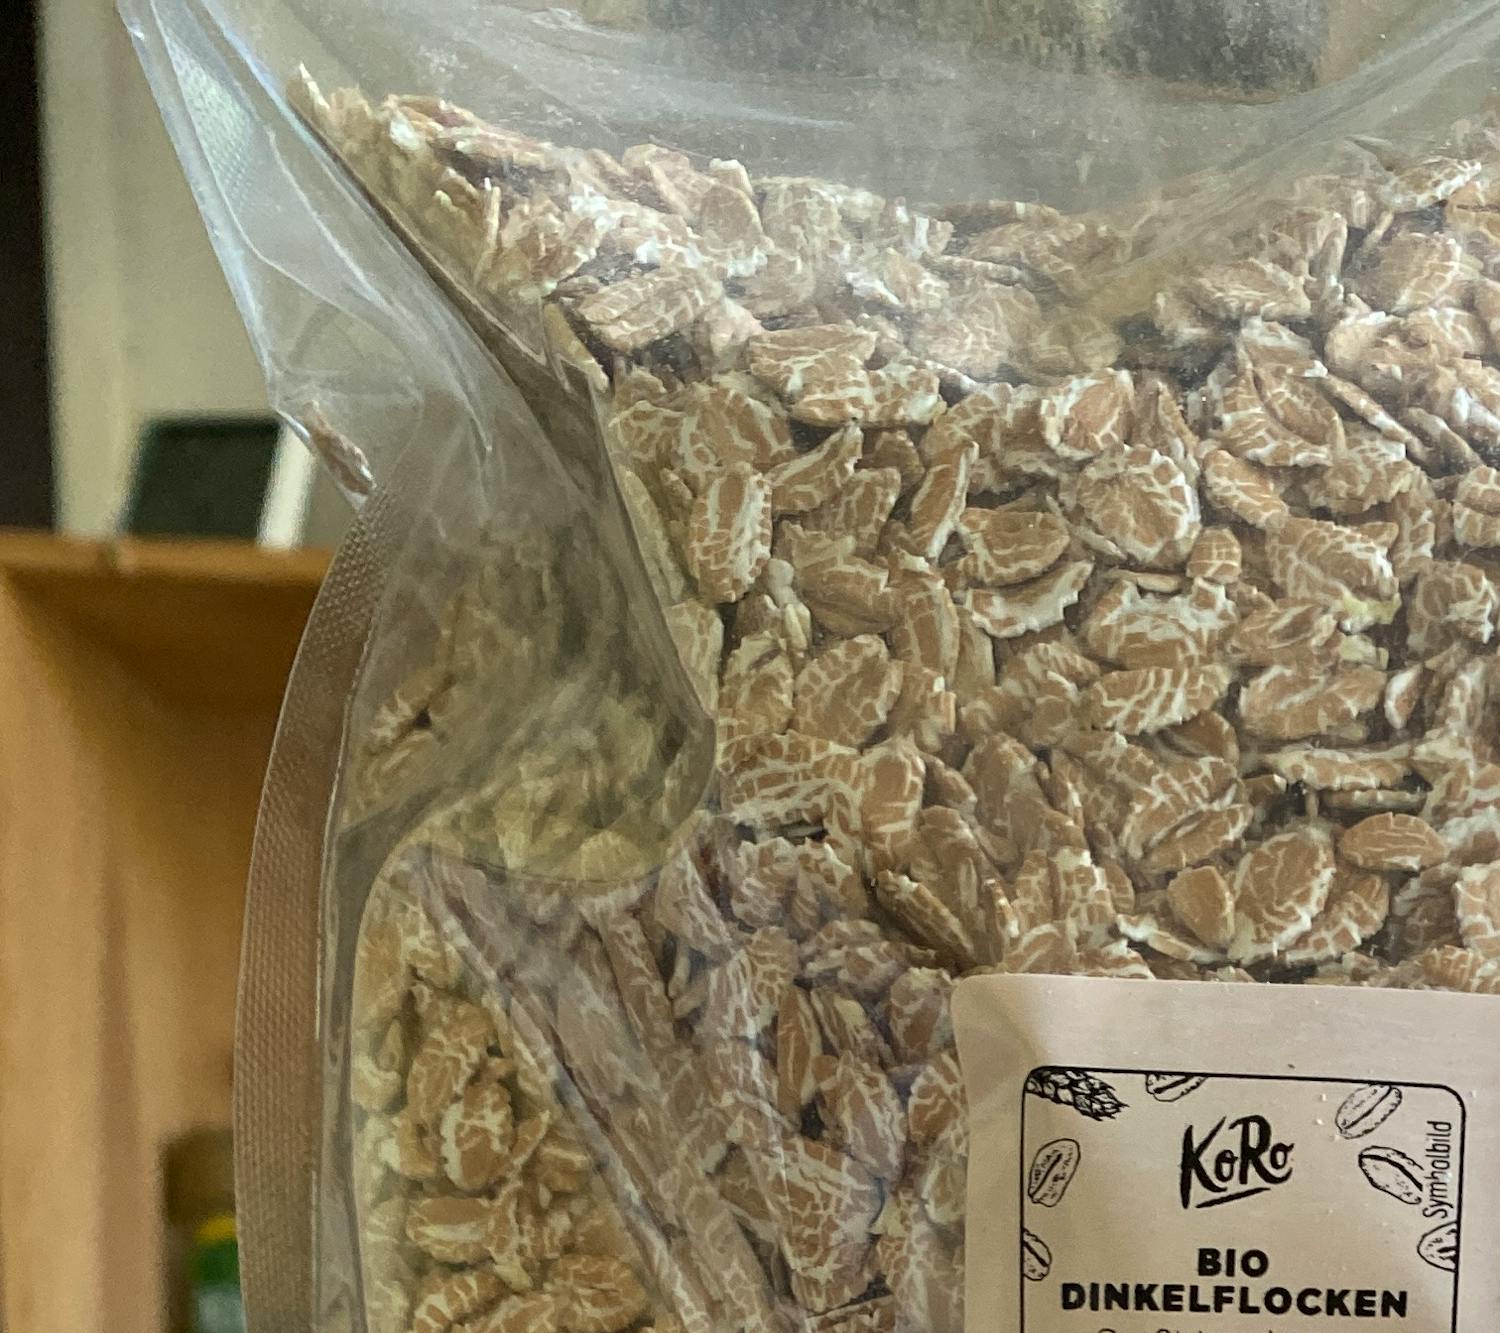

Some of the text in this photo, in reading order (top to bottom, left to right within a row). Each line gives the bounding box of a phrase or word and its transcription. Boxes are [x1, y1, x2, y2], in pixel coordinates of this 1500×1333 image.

[1180, 1115, 1295, 1209] KoRo
[1197, 1248, 1269, 1278] BIO
[1061, 1282, 1407, 1318] DINKELFLOCKEN
